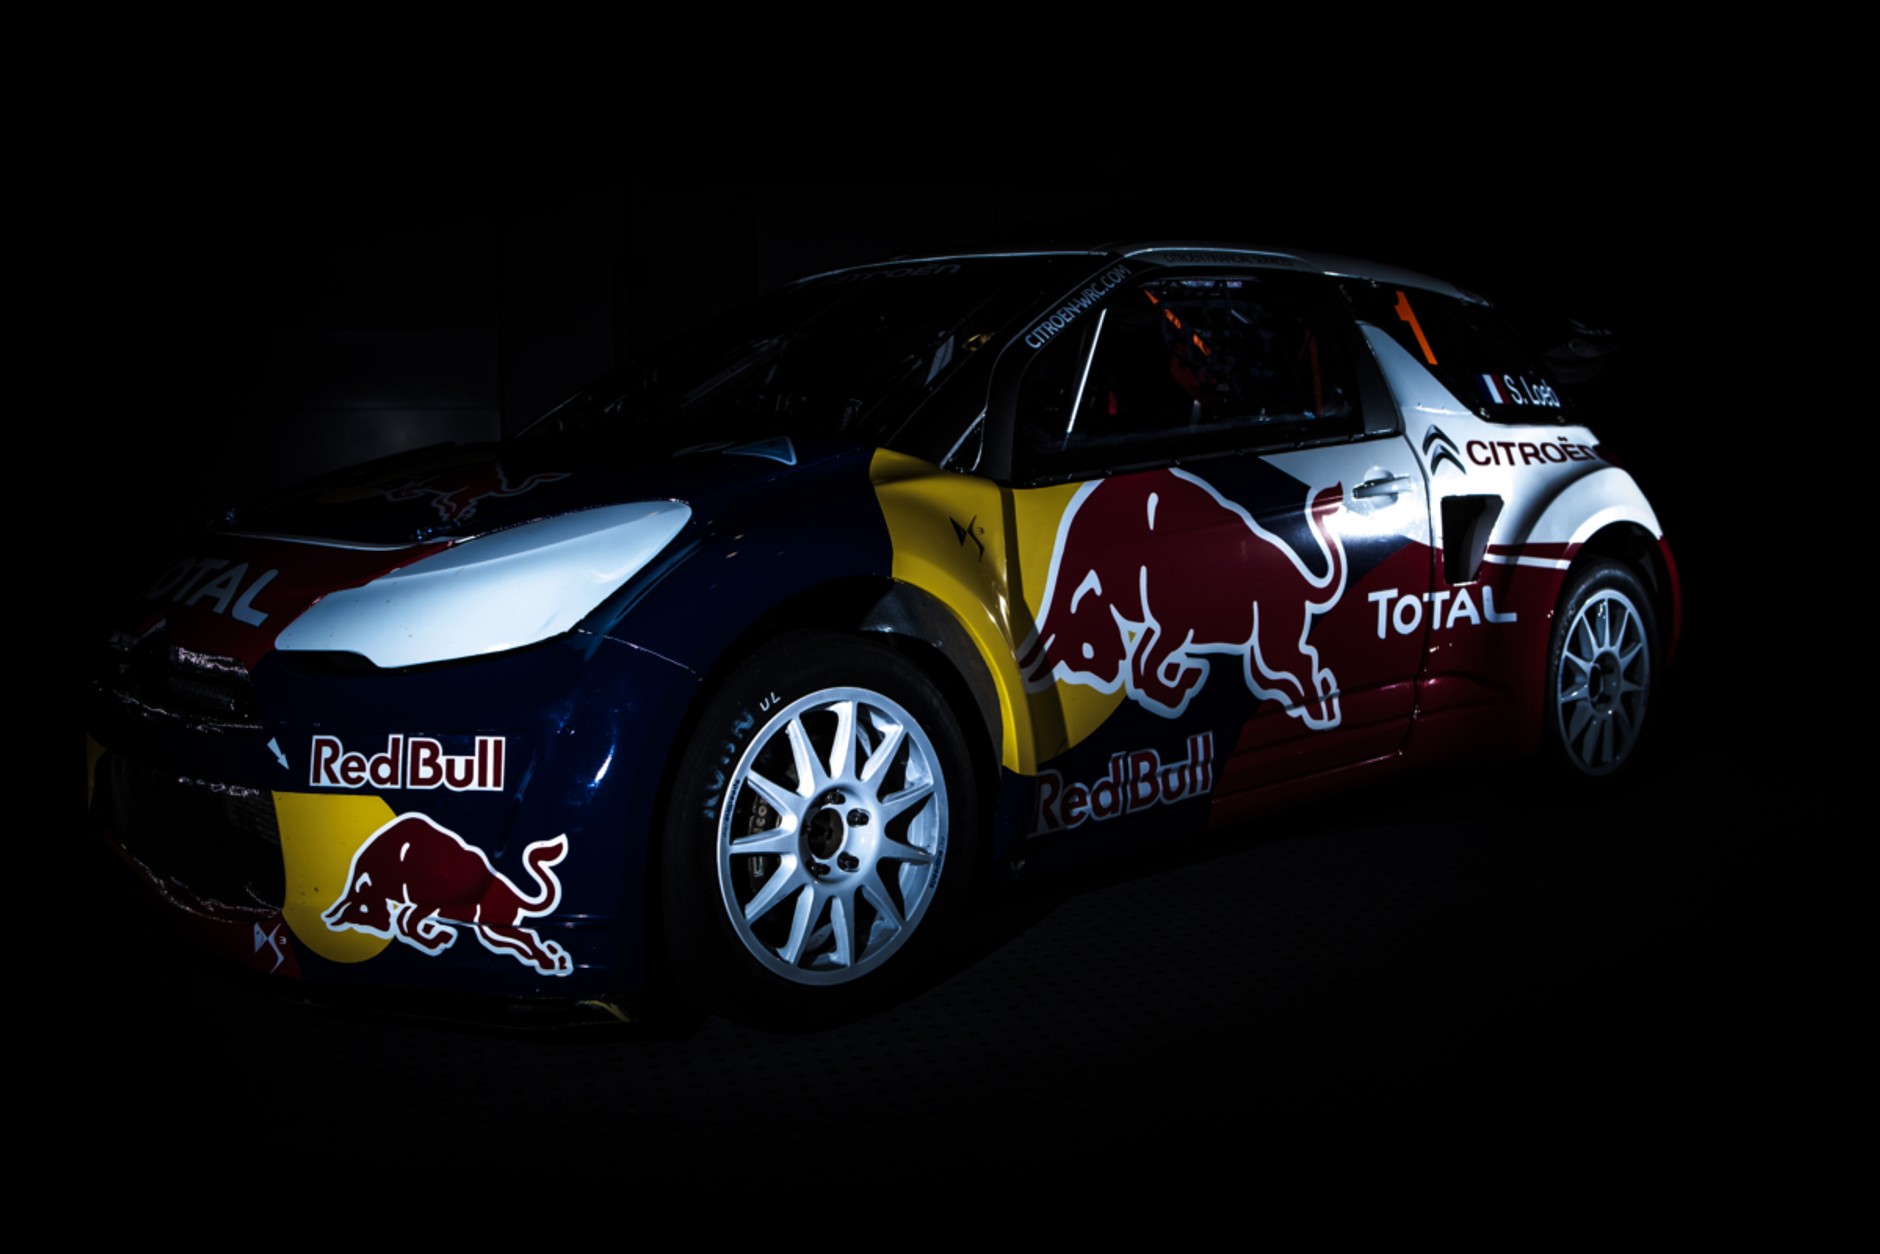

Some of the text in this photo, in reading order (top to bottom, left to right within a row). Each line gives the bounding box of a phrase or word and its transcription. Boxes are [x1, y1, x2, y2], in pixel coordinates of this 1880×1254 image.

[1024, 264, 1132, 349] CITROEN-WRC.COM
[1394, 289, 1439, 366] 1
[1503, 373, 1529, 405] S.
[1367, 584, 1518, 640] TOTAL
[759, 691, 782, 712] UL
[309, 734, 506, 792] Red Bull
[1028, 730, 1214, 839] Red Bull
